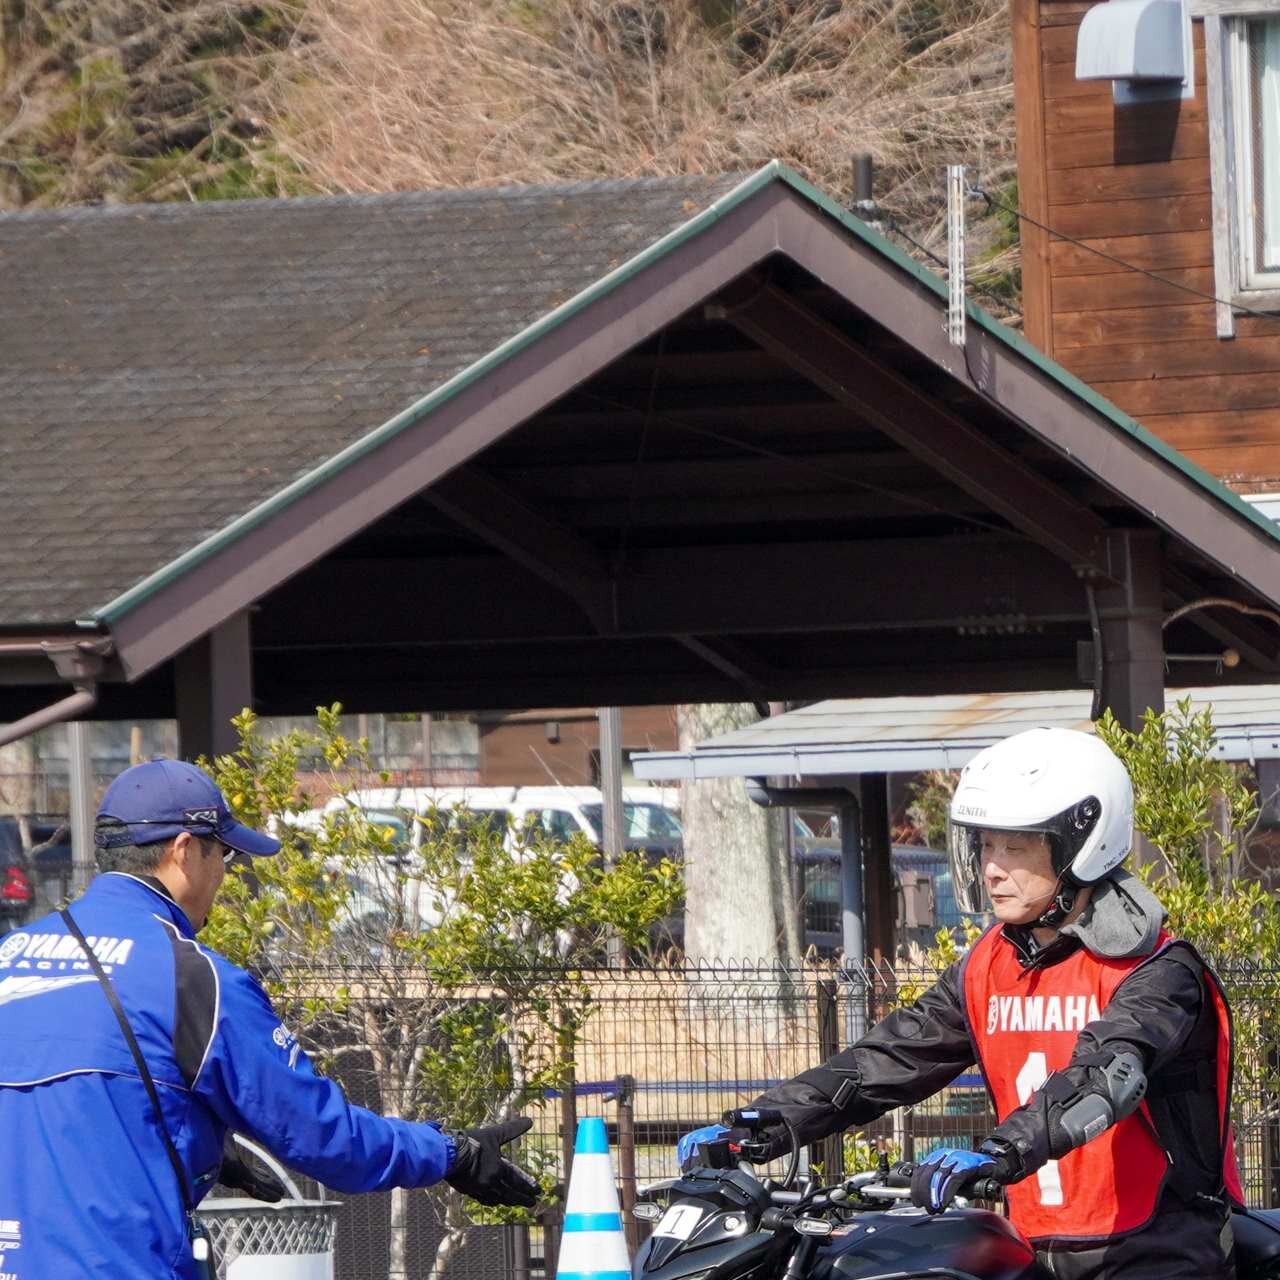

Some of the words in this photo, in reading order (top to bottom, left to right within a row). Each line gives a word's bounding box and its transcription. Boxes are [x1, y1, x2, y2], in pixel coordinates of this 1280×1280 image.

[23, 934, 134, 965] YAMAHA
[1000, 994, 1102, 1032] YAMAHA
[663, 1208, 687, 1235] 1
